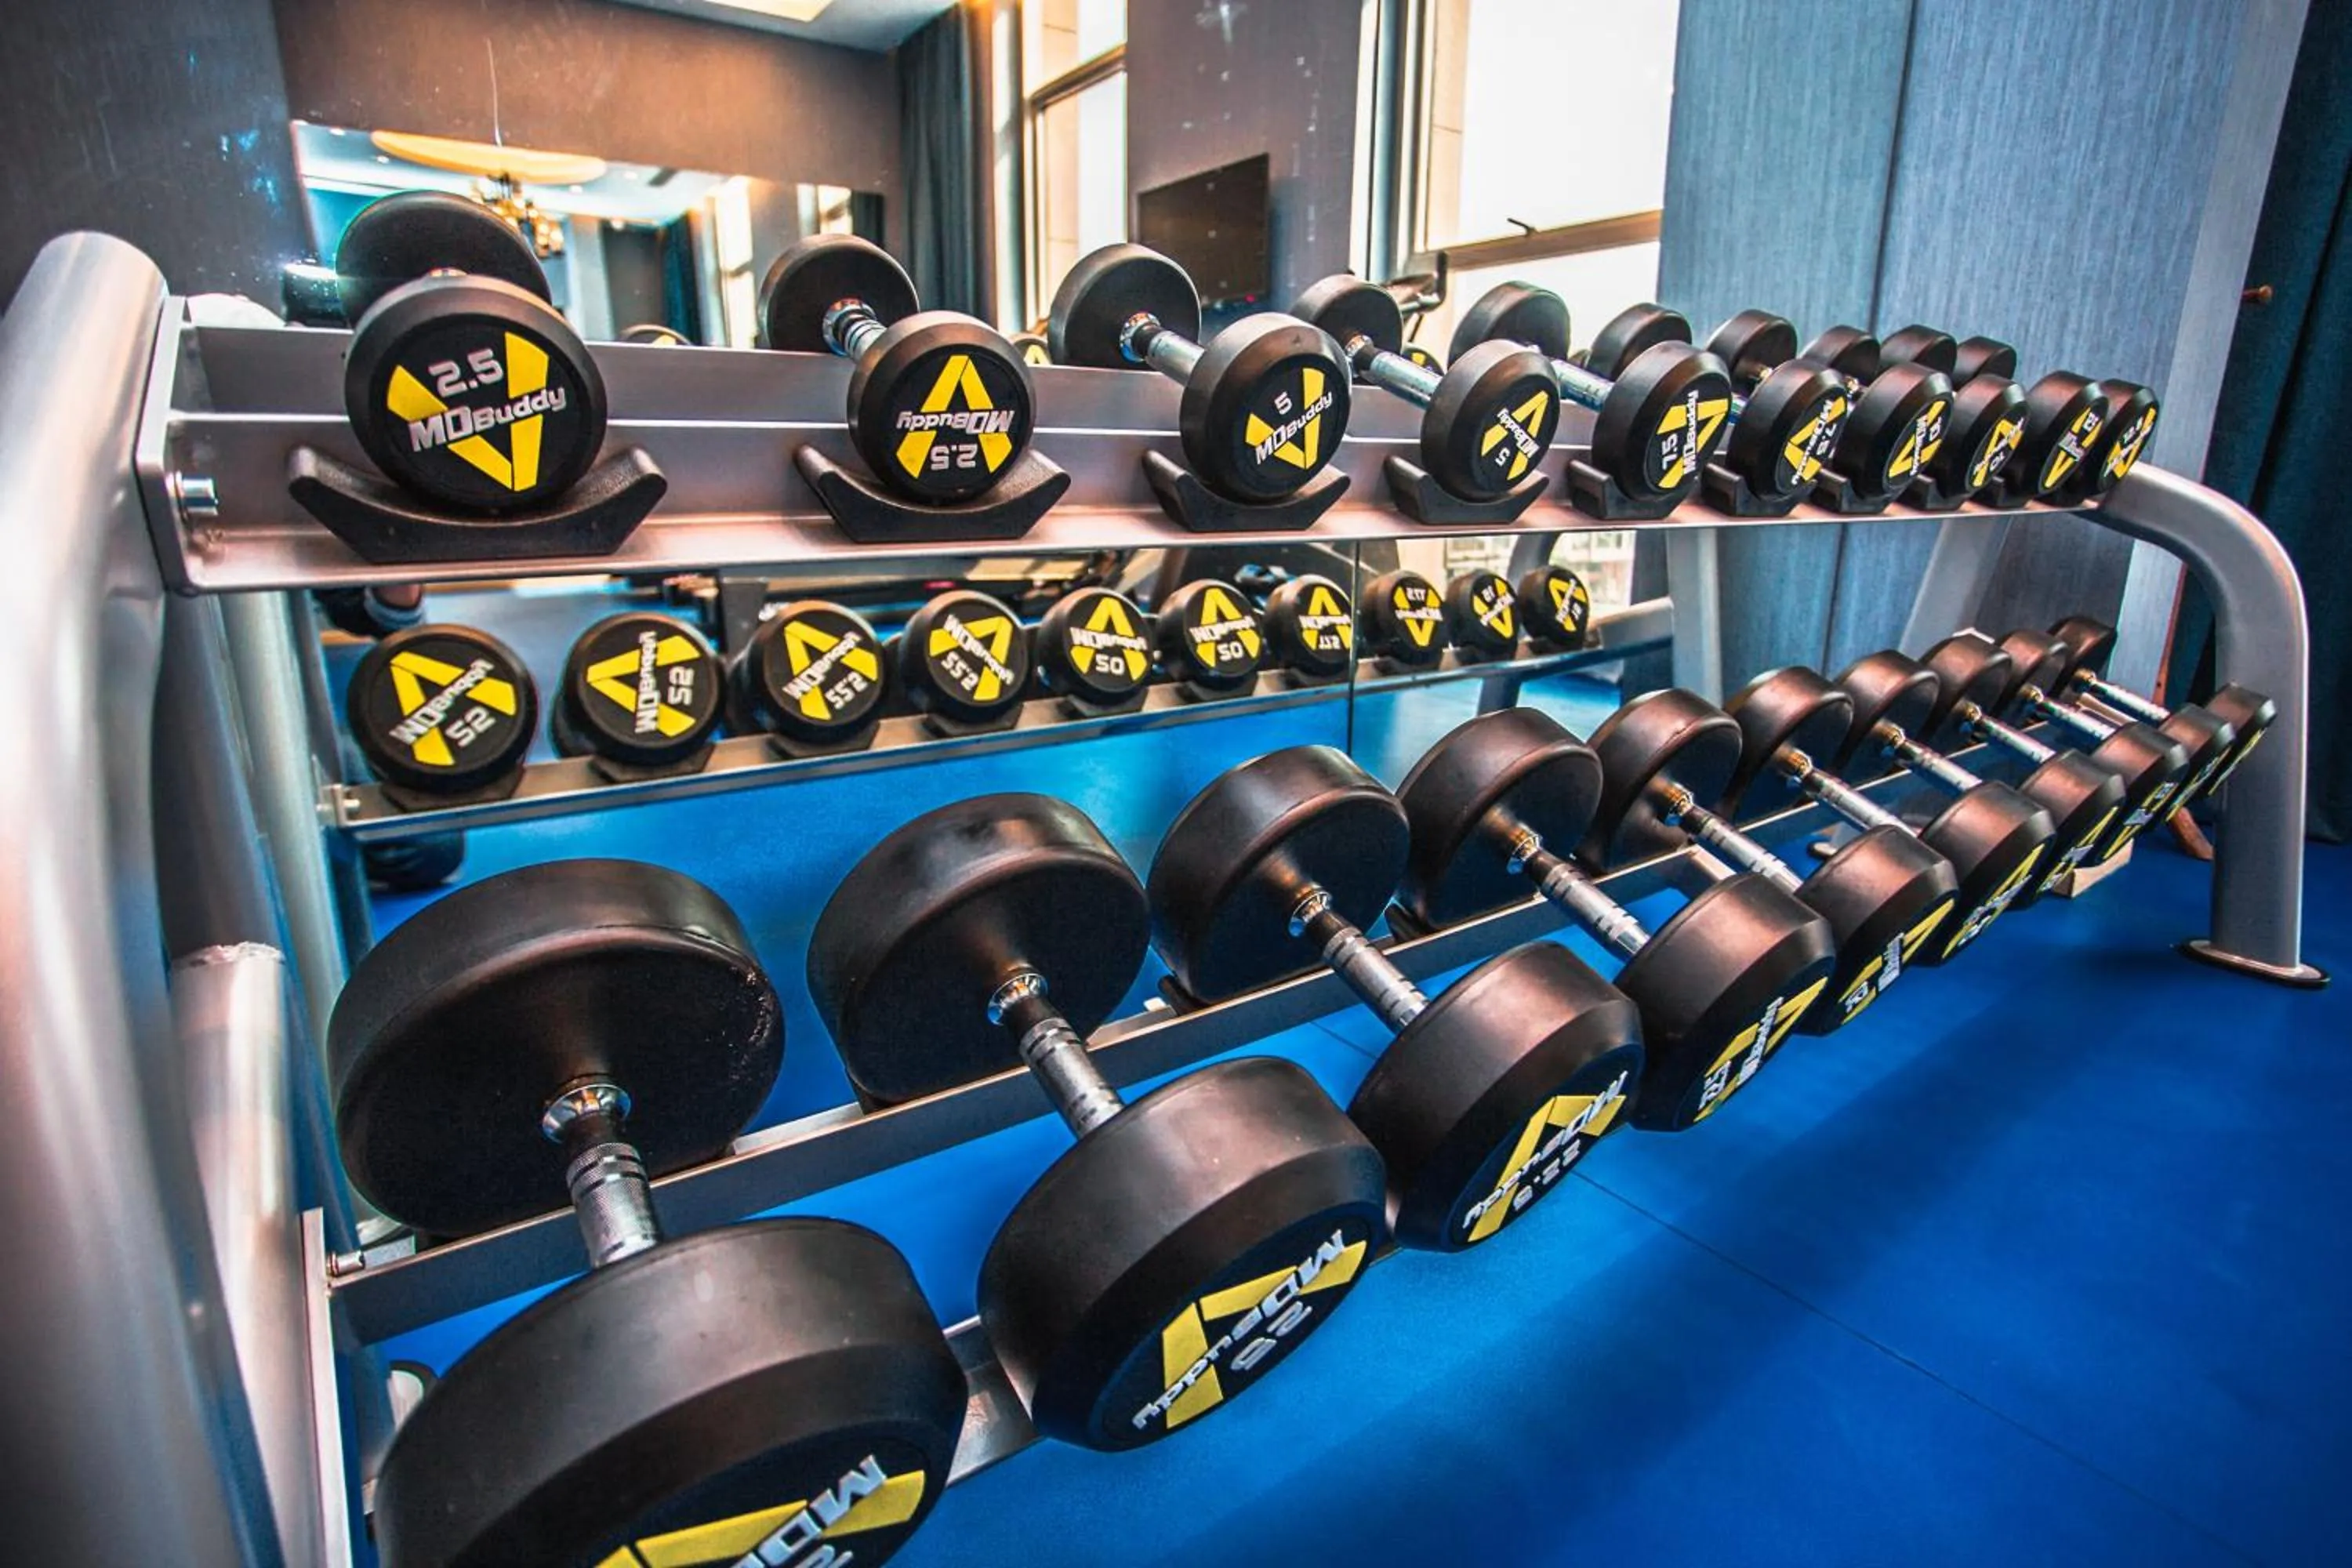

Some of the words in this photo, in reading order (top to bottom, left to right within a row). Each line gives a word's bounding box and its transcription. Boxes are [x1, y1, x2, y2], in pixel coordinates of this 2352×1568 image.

[427, 347, 503, 397] 2.5
[408, 387, 566, 452] MDBuddy
[896, 410, 1015, 434] MDBuddy
[1255, 391, 1332, 465] MDBuddy
[1274, 391, 1293, 416] 5
[930, 445, 978, 470] 2.5
[1494, 448, 1511, 466] 5
[1661, 433, 1679, 470] 7.5
[1462, 1070, 1628, 1229] MDBuddy
[1512, 1138, 1581, 1211] 22.5
[1132, 1229, 1344, 1429] MDBuddy
[1230, 1301, 1312, 1370] 25
